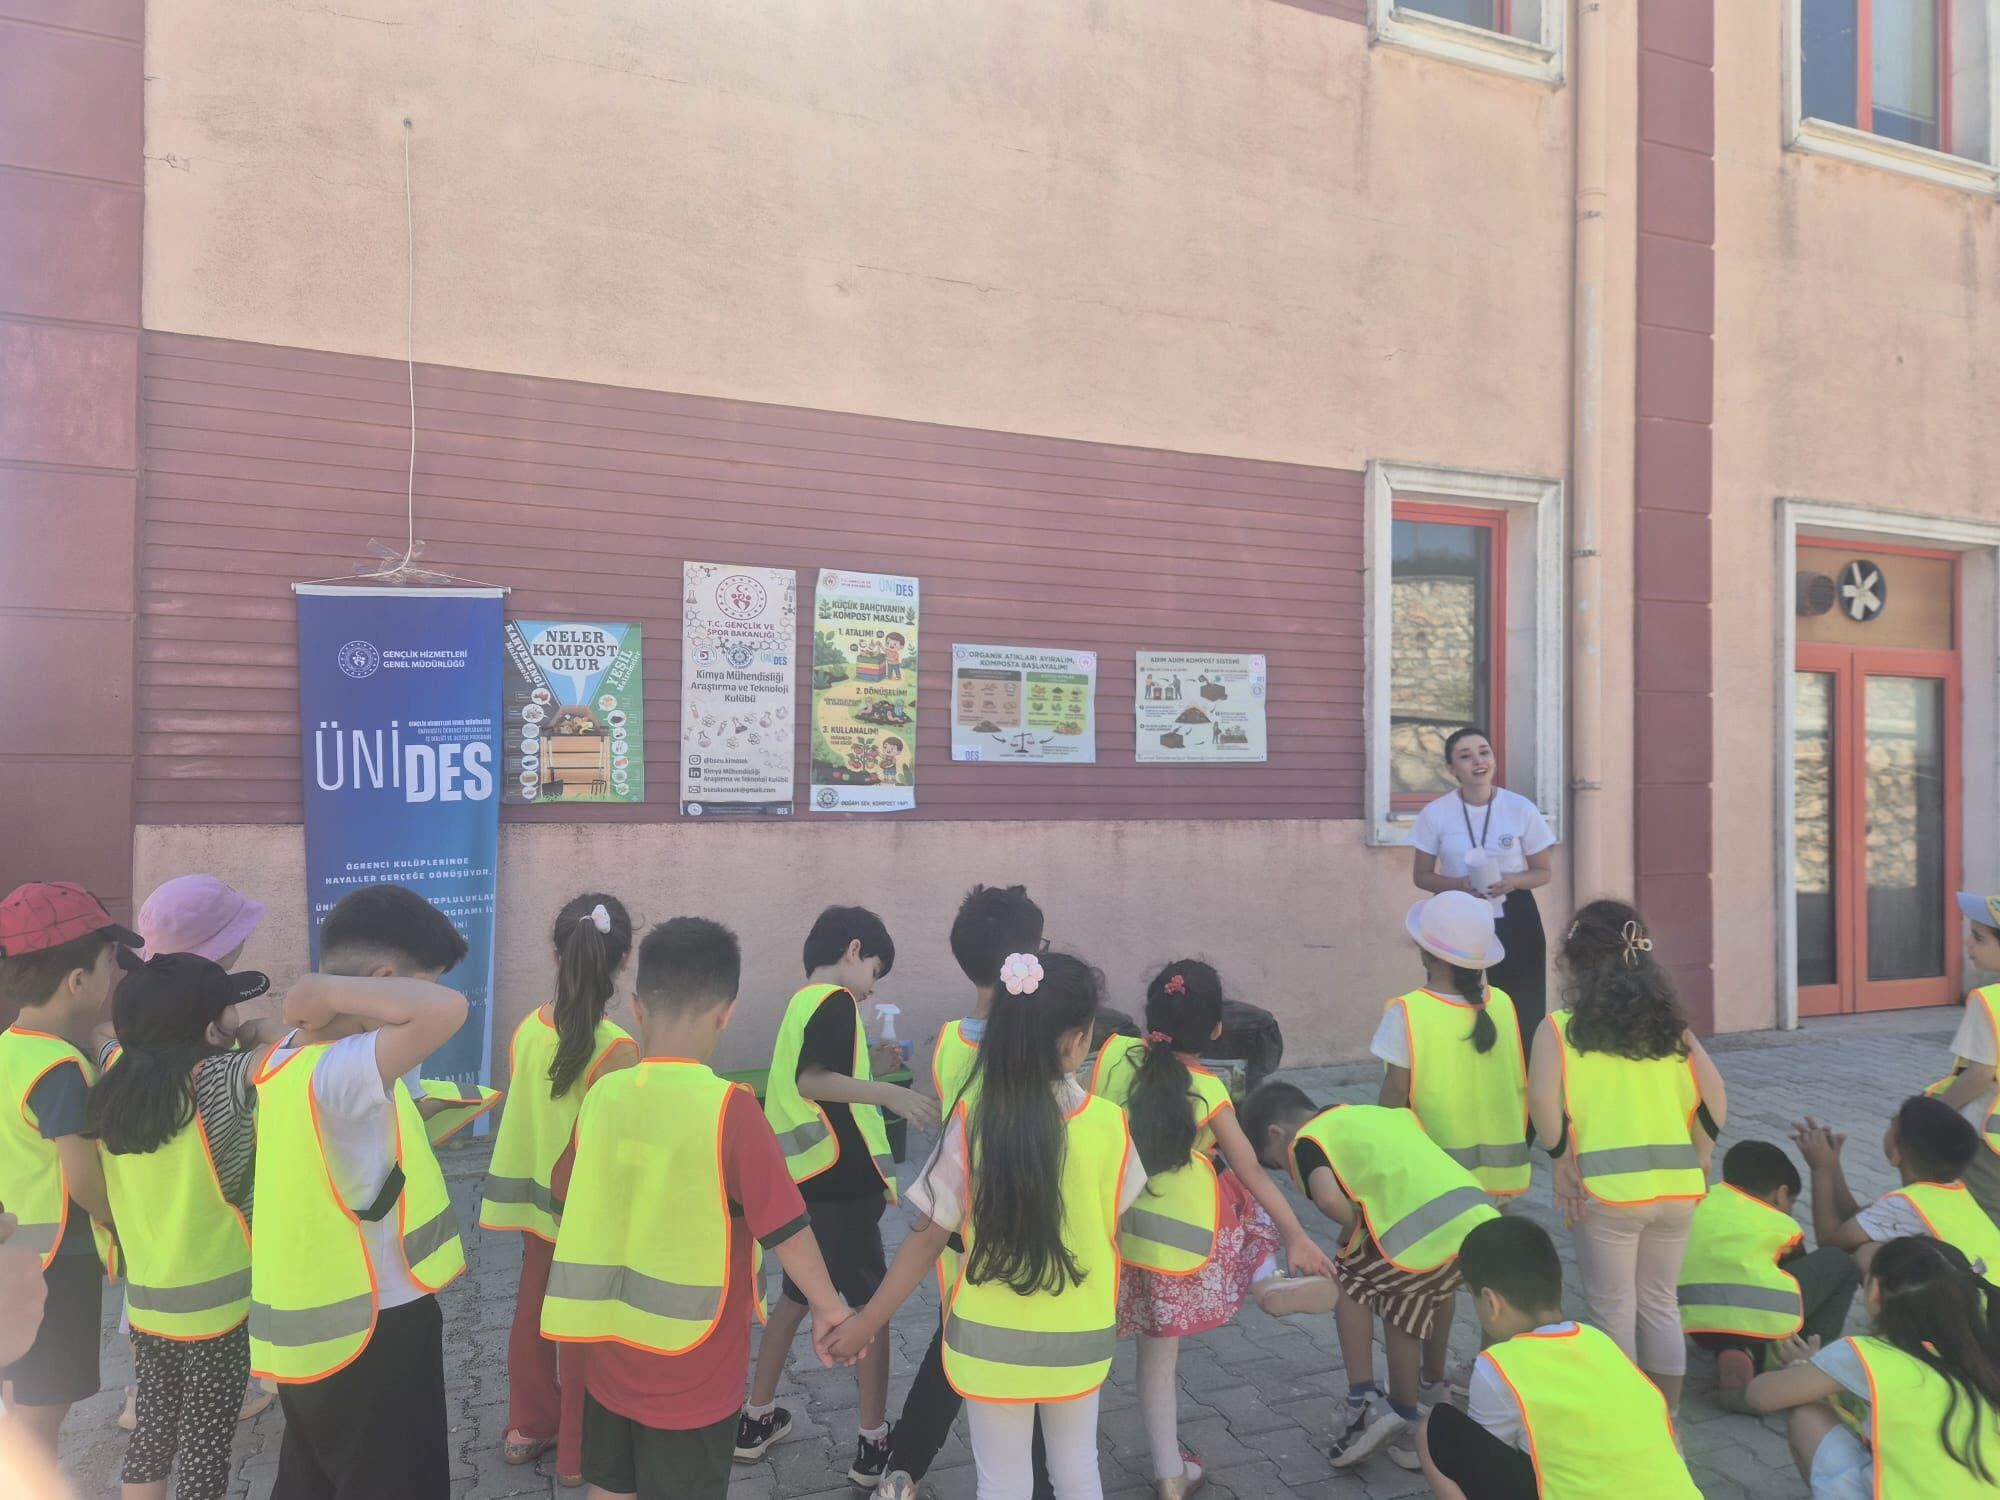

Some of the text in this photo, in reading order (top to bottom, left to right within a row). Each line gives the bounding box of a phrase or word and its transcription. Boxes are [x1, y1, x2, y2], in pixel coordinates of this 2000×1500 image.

[832, 601, 906, 614] KÜÇÜK BAHÇIVANIN
[833, 611, 904, 624] KOMPOST MASALI!
[725, 621, 762, 630] GENÇLİK
[546, 631, 604, 643] NELER
[731, 629, 775, 639] BAKANLIĞI
[845, 628, 874, 637] ATALIM!
[383, 650, 467, 659] GENÇLİK HİZMETLERİ
[532, 644, 617, 657] KOMPOST
[969, 651, 1002, 660] ORGANİK
[1004, 653, 1037, 661] ATIKLARI
[412, 660, 465, 668] MÜDÜRLÜĞÜ
[552, 658, 600, 671] OLUR
[980, 660, 1020, 668] KOMPOSTA
[696, 670, 784, 683] Kimya Mühendisliği
[691, 682, 736, 692] Araştırma
[750, 684, 789, 694] Teknoloji
[856, 687, 907, 696] 2. DÖNÜŞELİM!
[725, 694, 756, 703] Kulübü
[831, 726, 879, 736] KULLANALIM!
[325, 875, 376, 885] HAYALLER
[380, 871, 424, 881] GERÇEĞE
